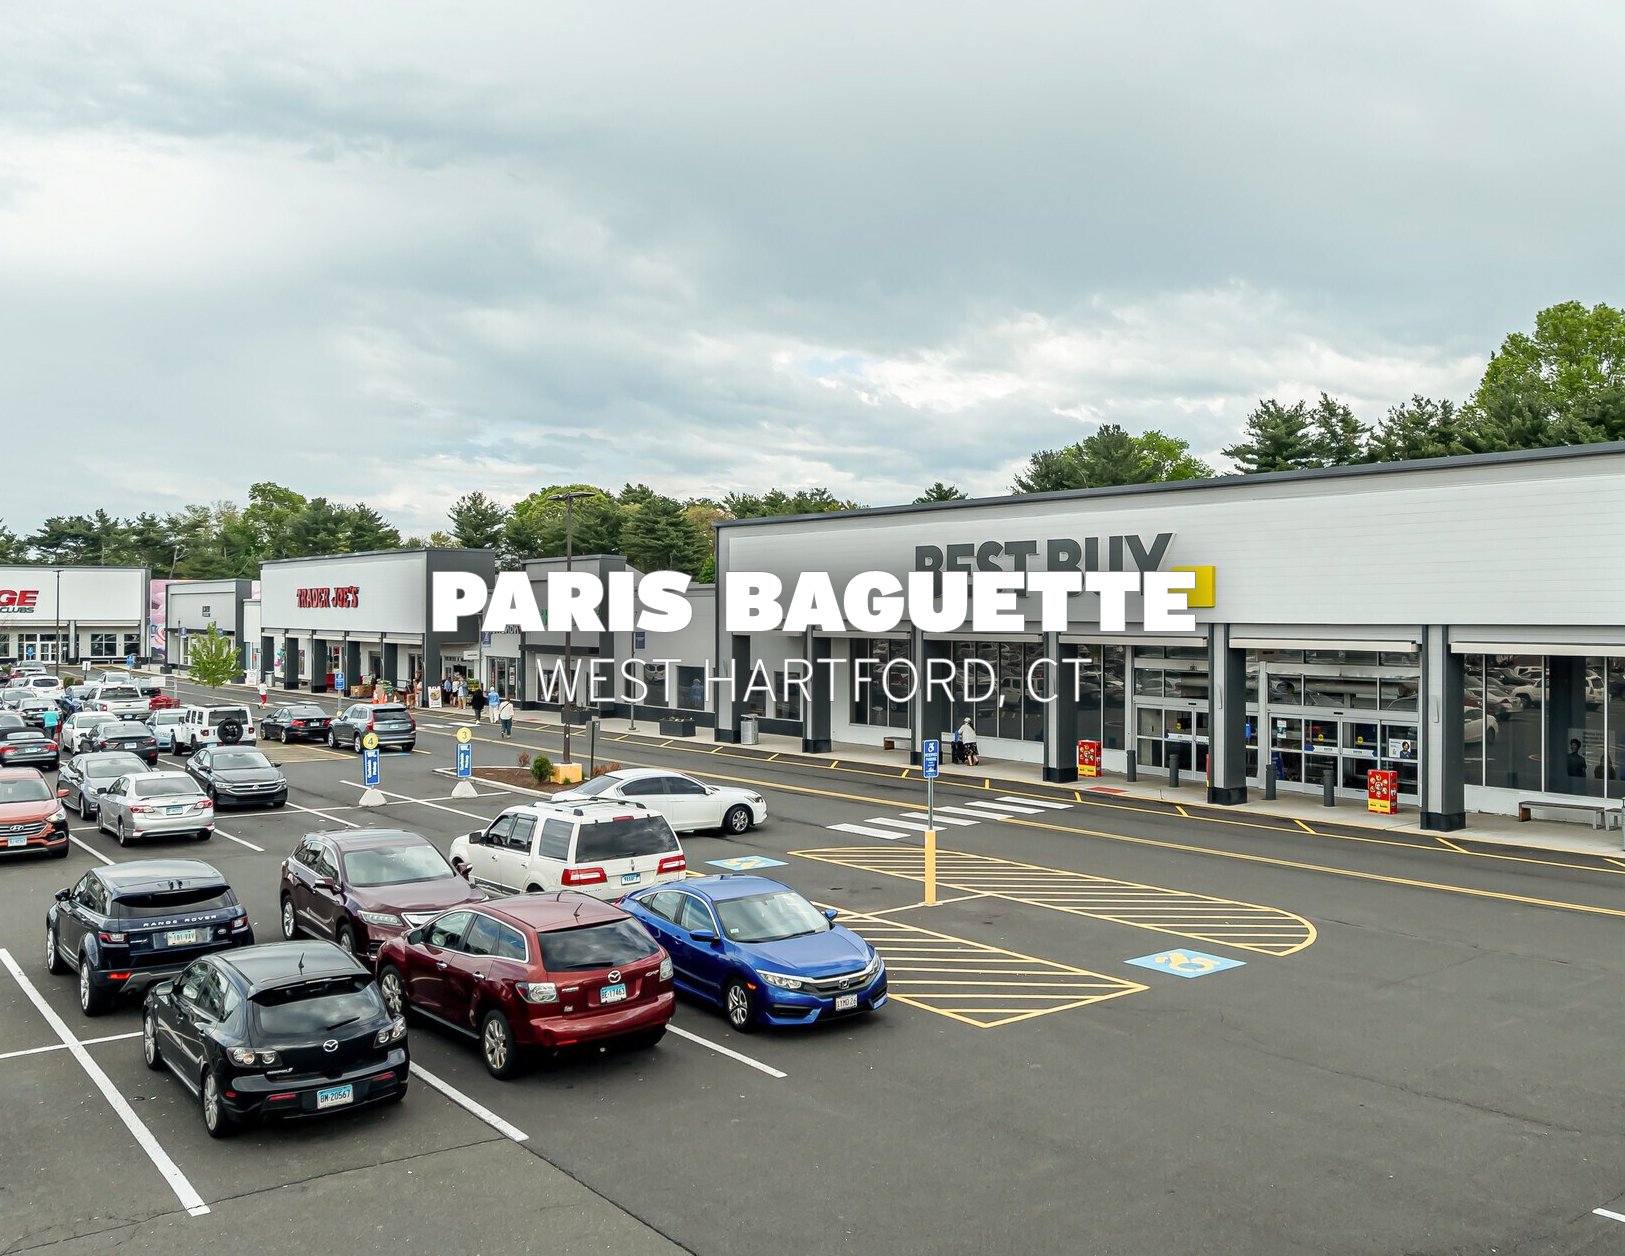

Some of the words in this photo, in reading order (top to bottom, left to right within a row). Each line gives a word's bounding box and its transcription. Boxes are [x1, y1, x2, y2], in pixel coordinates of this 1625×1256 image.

[915, 539, 1039, 598] BEST
[1046, 533, 1175, 598] BUY
[297, 588, 331, 608] TRADER
[332, 586, 359, 608] JOE'S
[462, 731, 467, 739] 3
[368, 737, 373, 745] 4
[184, 914, 217, 924] ROVER
